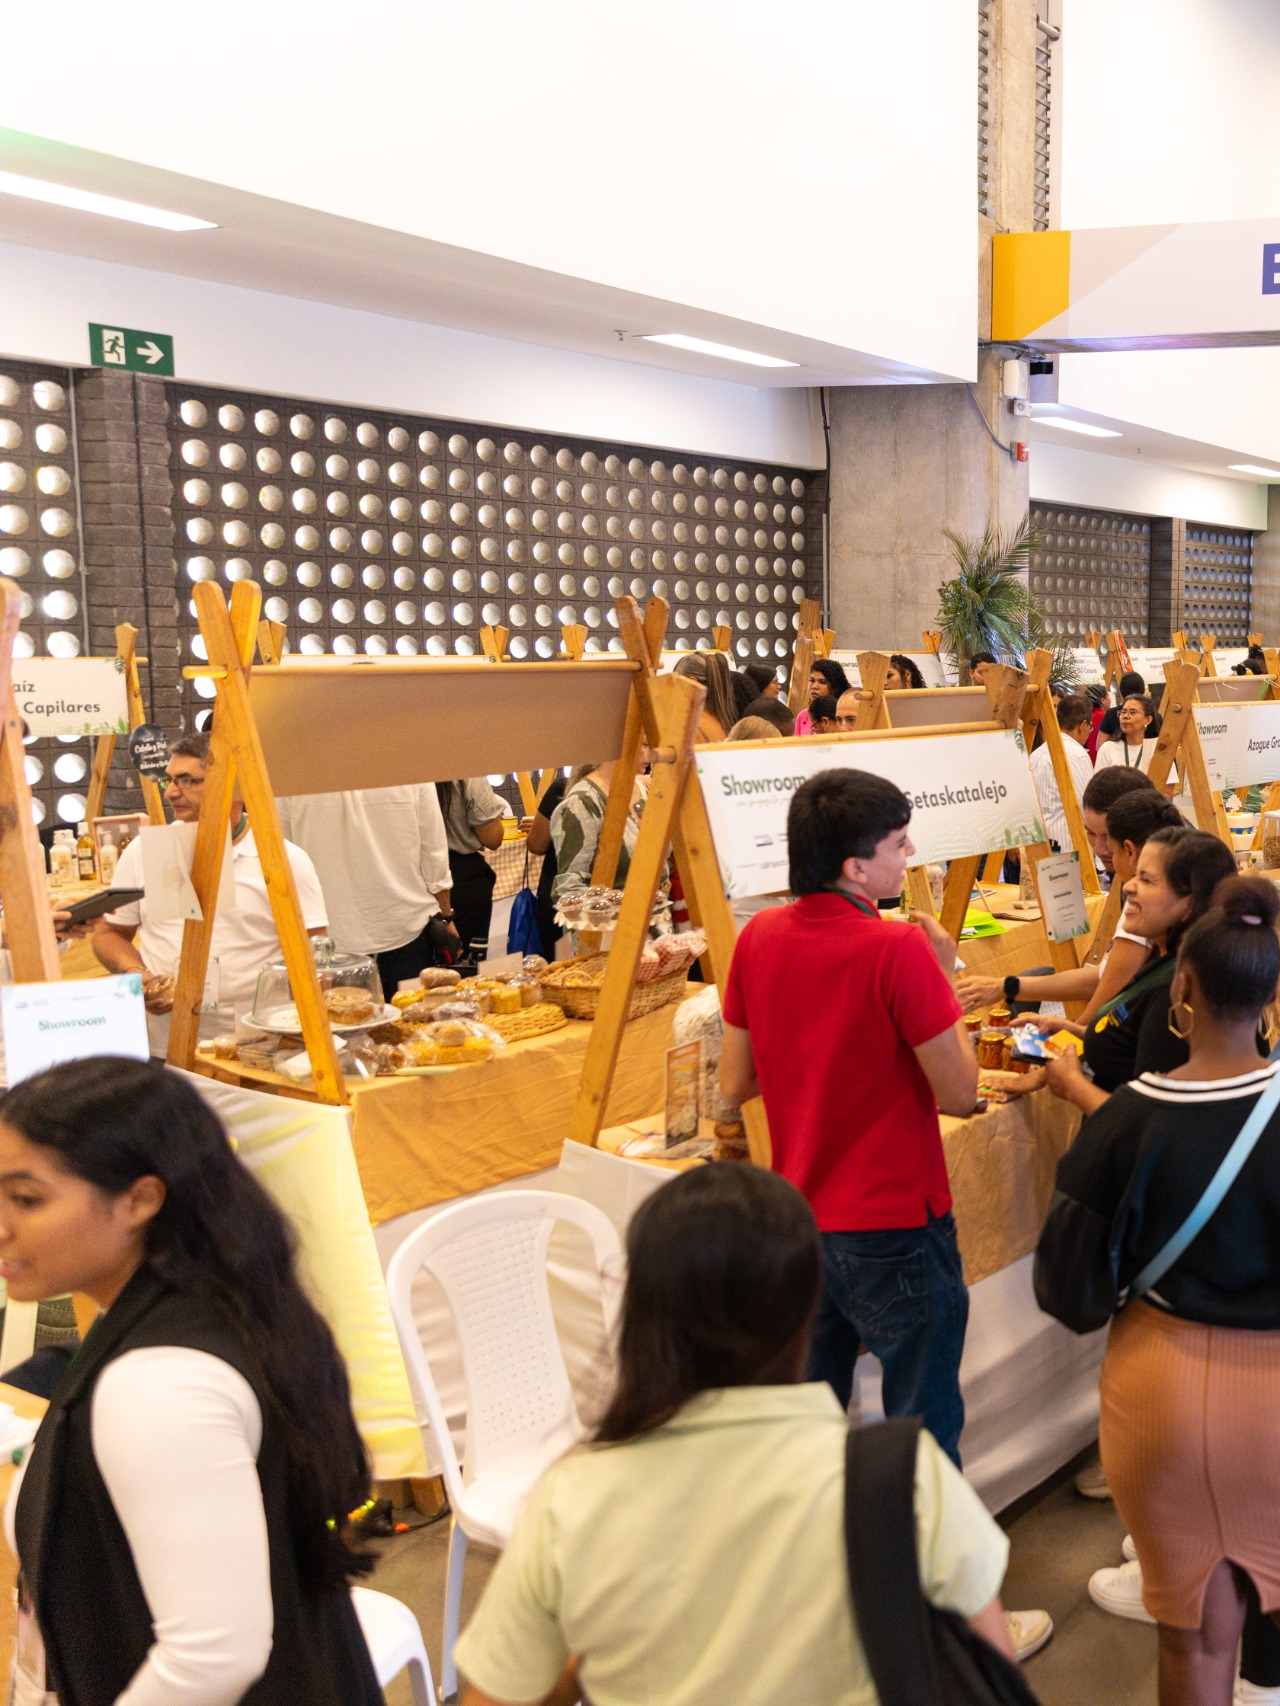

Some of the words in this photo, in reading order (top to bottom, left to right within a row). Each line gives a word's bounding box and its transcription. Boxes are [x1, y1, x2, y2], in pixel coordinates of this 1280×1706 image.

[13, 680, 36, 693] aíz
[23, 701, 101, 717] Capilares
[1247, 738, 1270, 754] Azogue
[904, 780, 1007, 809] Setaskatalejo
[38, 1016, 106, 1031] Showroom
